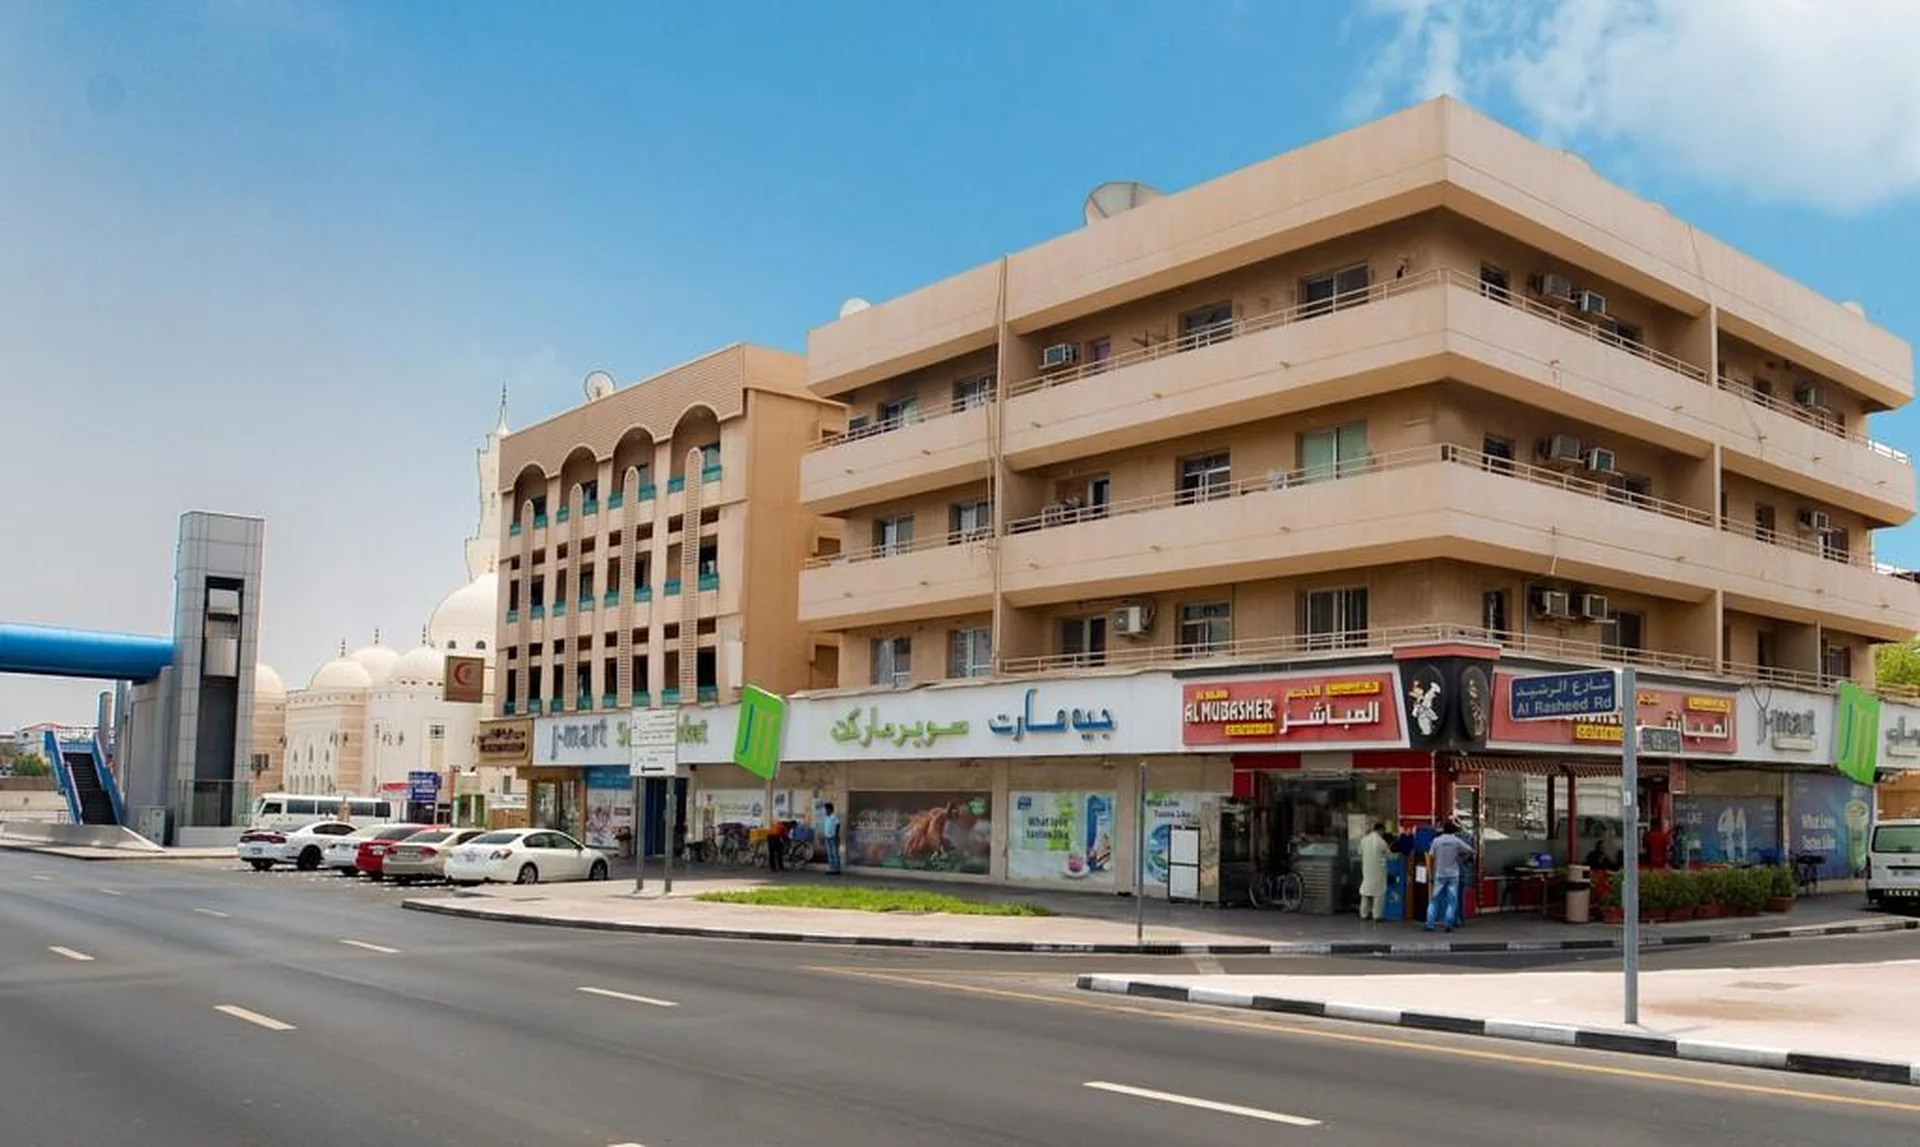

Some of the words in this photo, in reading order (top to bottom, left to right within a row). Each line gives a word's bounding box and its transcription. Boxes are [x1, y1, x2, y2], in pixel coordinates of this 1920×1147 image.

[1516, 680, 1567, 699] الرشيد
[1572, 678, 1611, 697] شارع
[1201, 699, 1275, 722] MUBASHER
[1517, 702, 1529, 716] Al
[1534, 698, 1589, 714] Rasheed
[1593, 696, 1613, 709] Rd
[1279, 701, 1379, 735] المباشر
